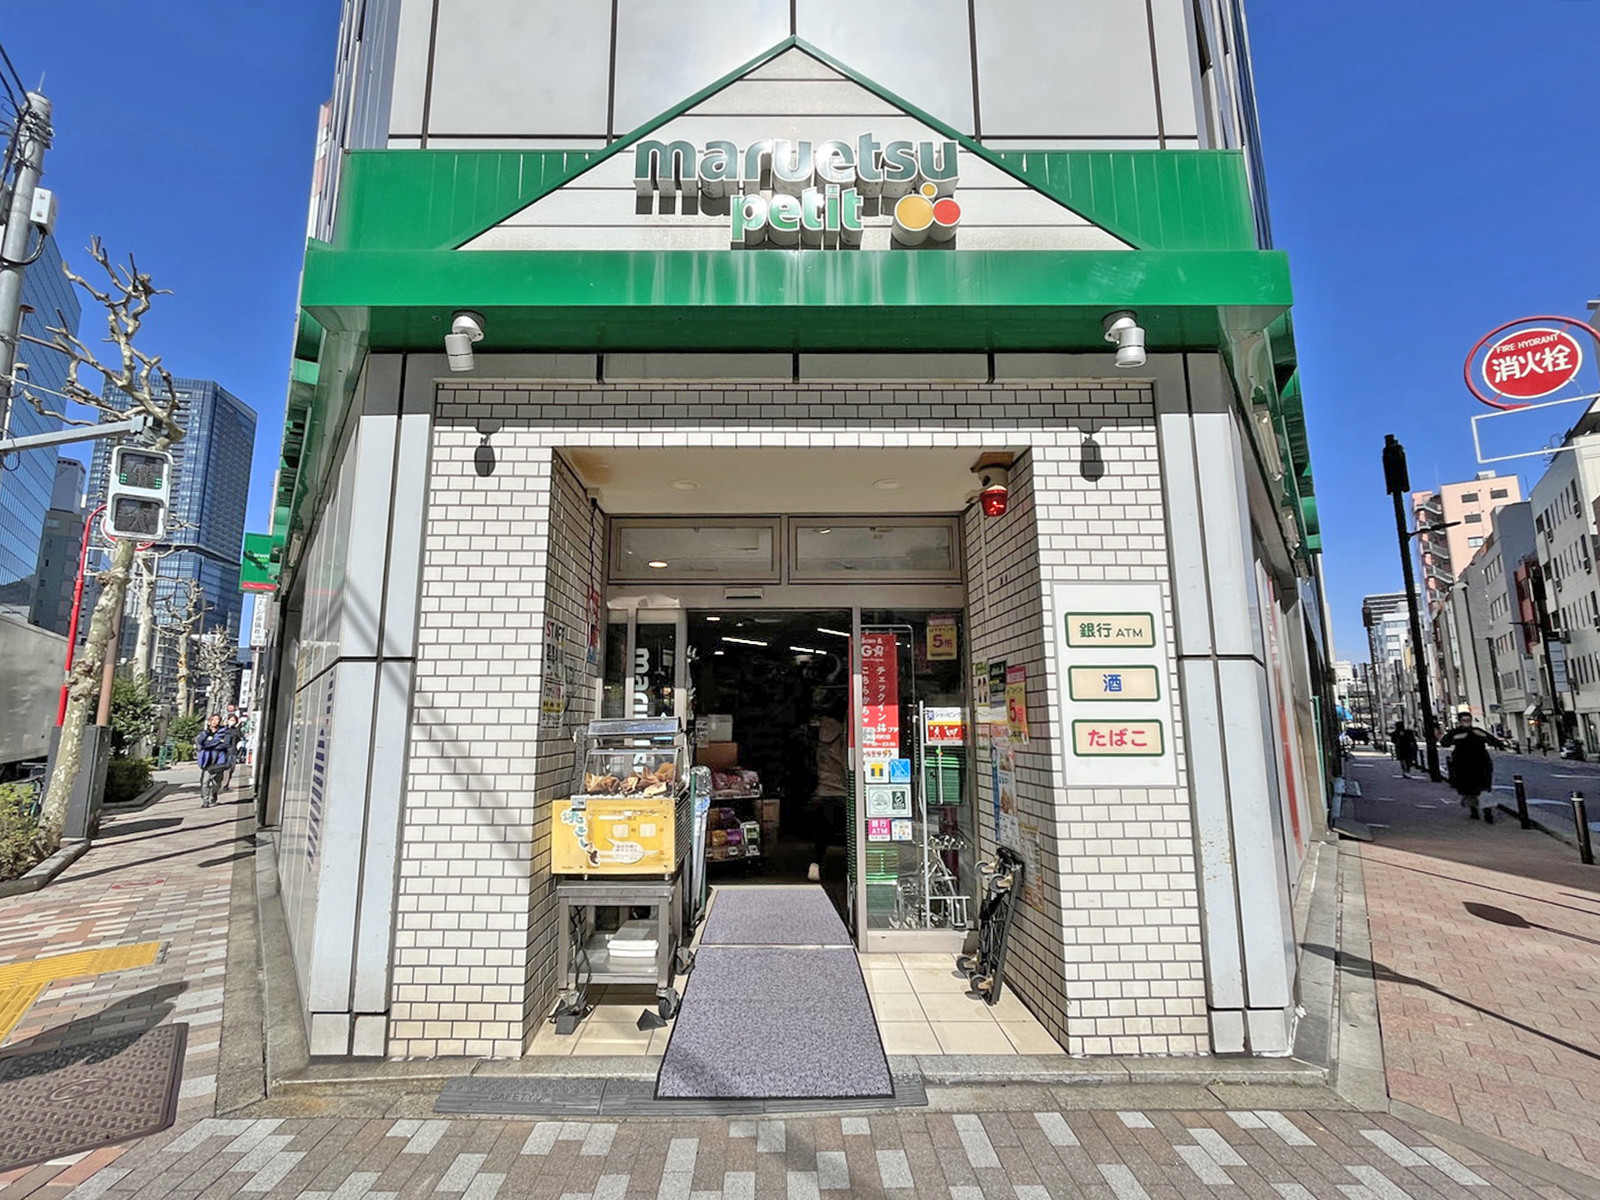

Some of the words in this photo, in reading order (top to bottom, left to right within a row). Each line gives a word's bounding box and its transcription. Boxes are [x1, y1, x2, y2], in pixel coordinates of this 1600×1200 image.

[635, 132, 960, 182] maruetsu
[730, 184, 864, 242] petit
[1496, 342, 1516, 354] FIRE
[1518, 334, 1559, 349] HYDRANT
[1491, 343, 1573, 384] 消火栓
[1079, 622, 1112, 638] 銀行
[1115, 628, 1144, 638] ATM
[1102, 673, 1123, 692] 酒
[1088, 728, 1148, 747] たばこ
